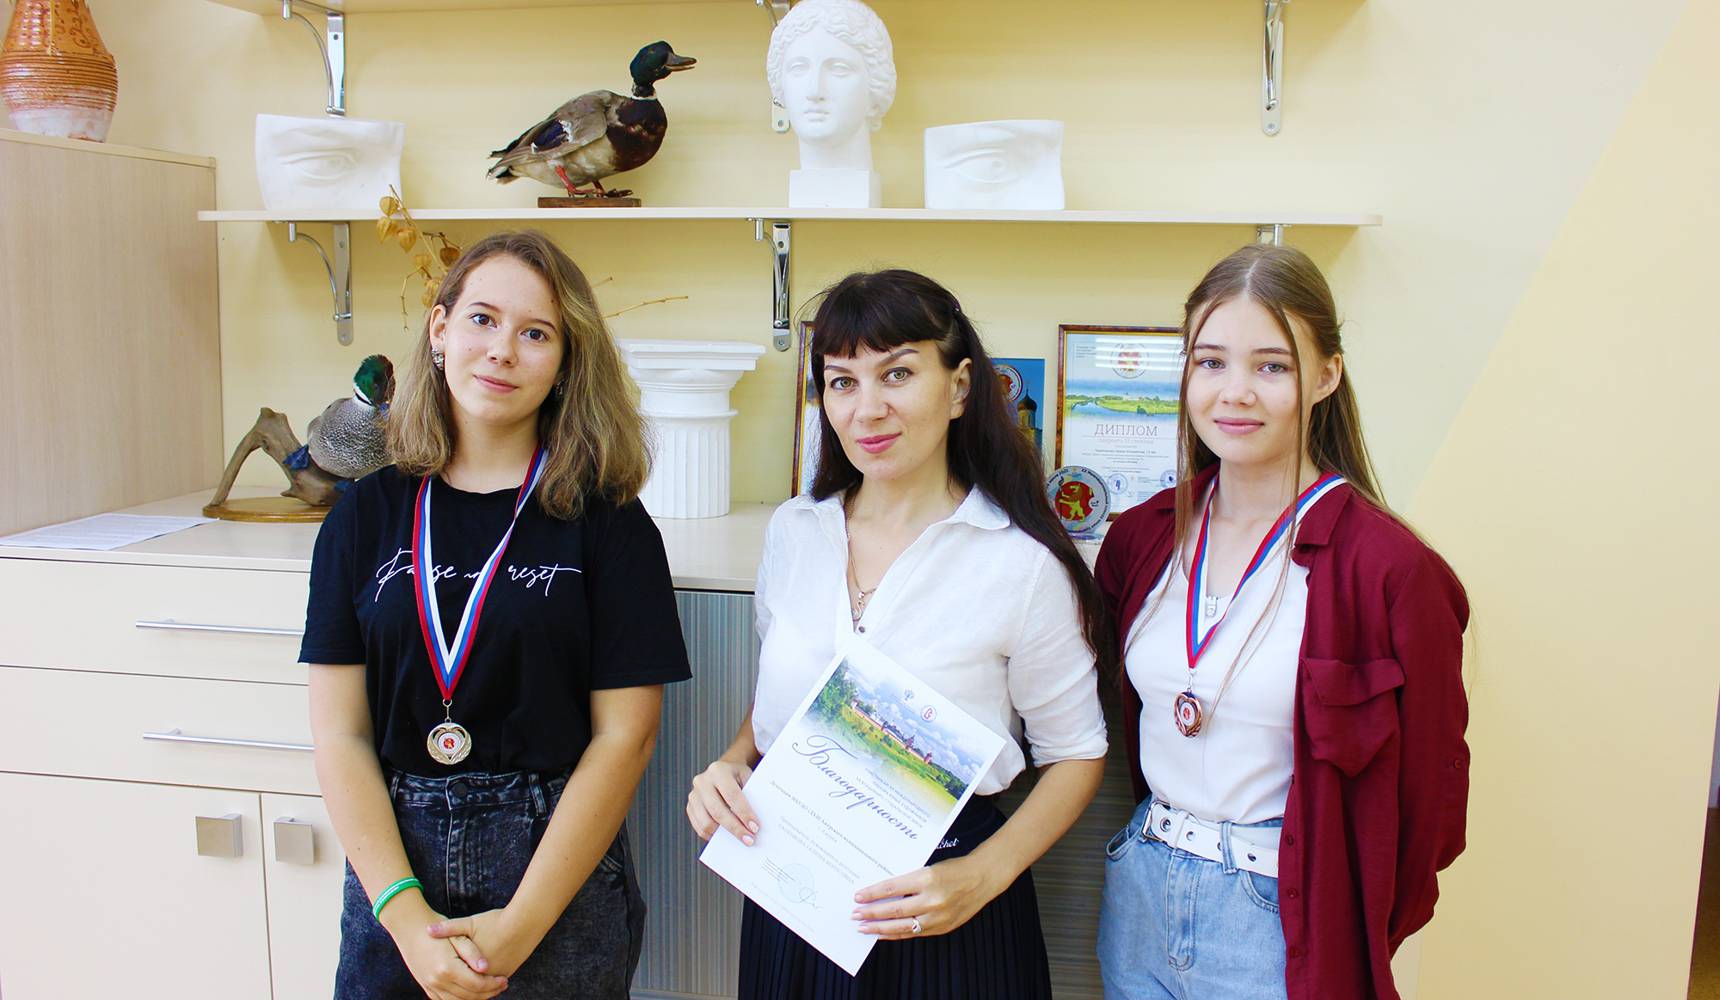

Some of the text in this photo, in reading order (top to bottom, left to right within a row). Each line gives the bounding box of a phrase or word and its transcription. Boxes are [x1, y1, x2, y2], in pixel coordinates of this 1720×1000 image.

[1094, 423, 1158, 437] ДИПЛОМ
[375, 547, 582, 603] Pase reset
[792, 734, 918, 840] Благодарность
